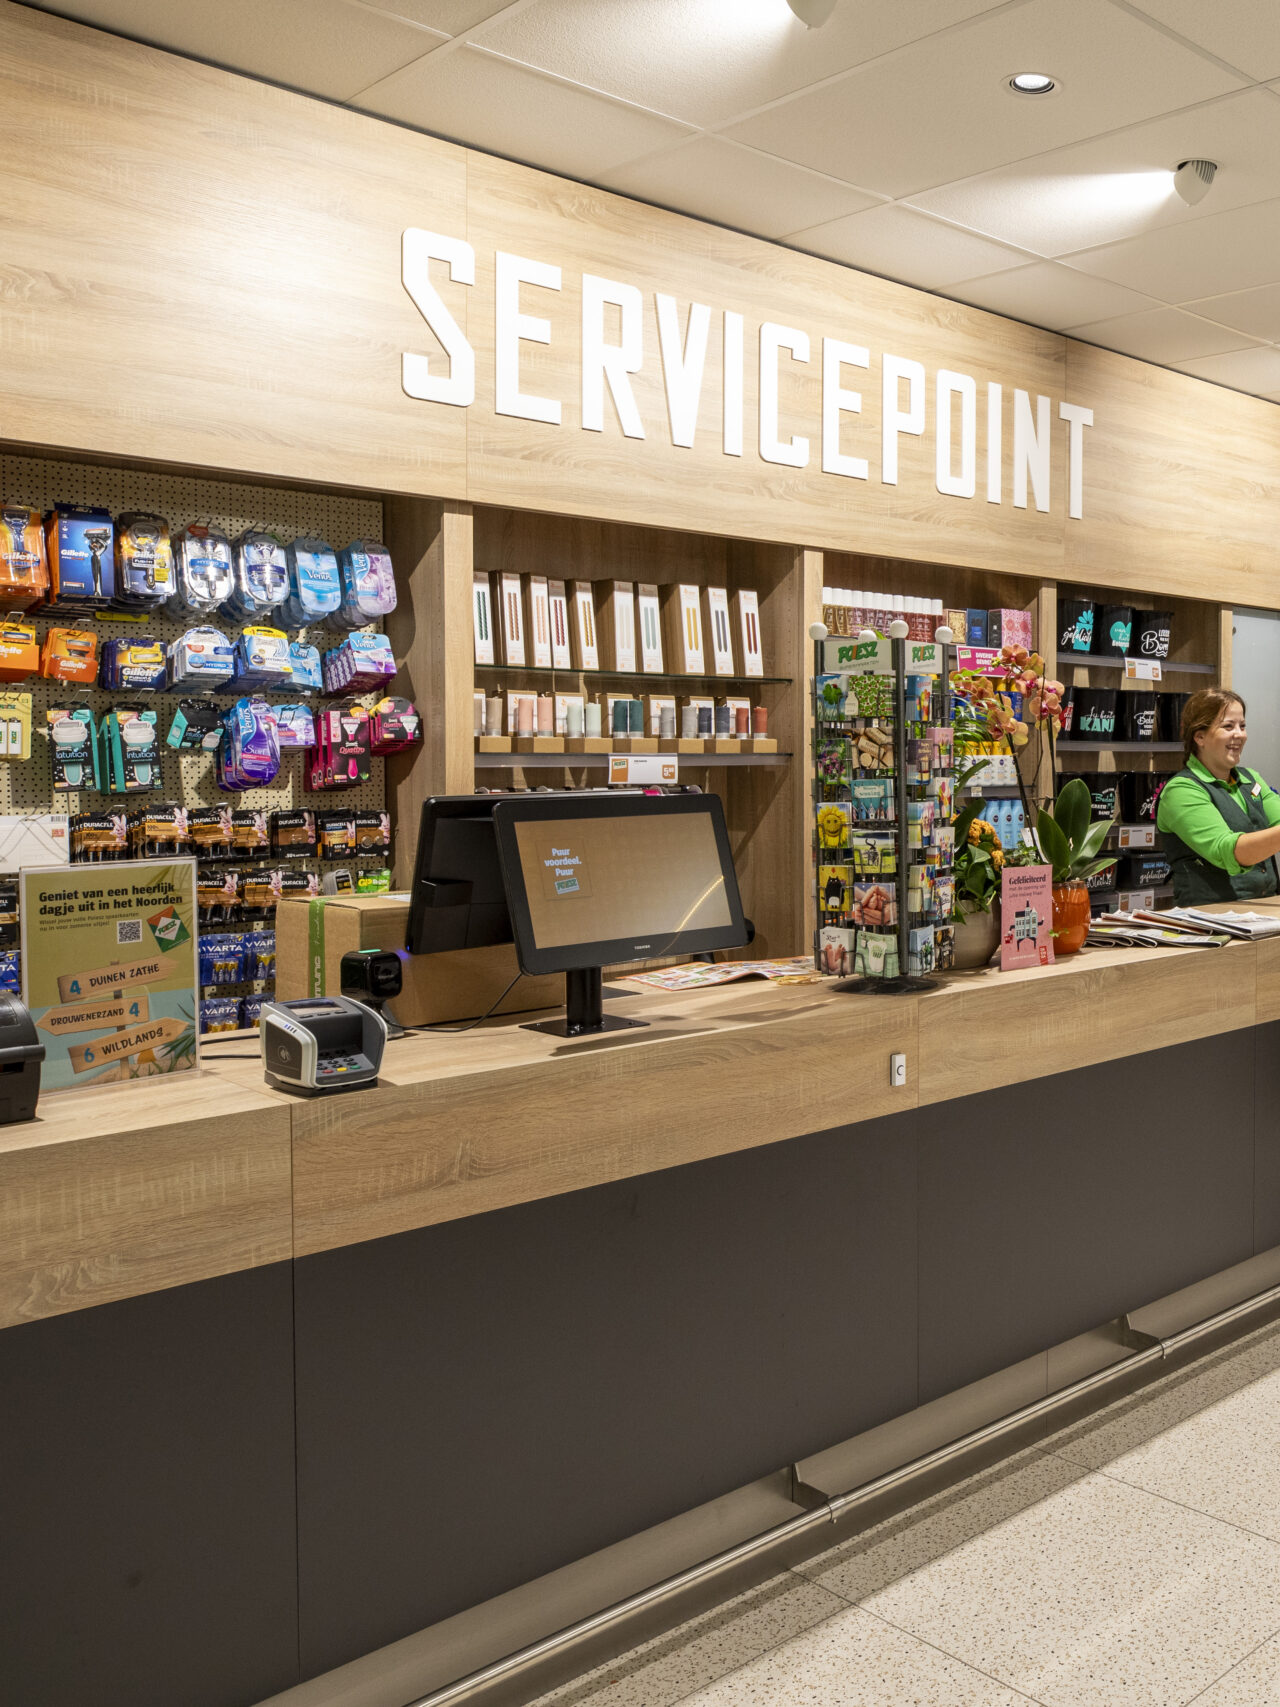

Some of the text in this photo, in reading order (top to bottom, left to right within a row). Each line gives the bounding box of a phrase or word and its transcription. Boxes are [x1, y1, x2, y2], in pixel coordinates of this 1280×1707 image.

[402, 227, 1094, 520] SERVICEPOINT
[60, 549, 89, 558] Gillette
[305, 568, 333, 580] Venus
[352, 639, 377, 649] Venus
[838, 641, 878, 664] POIESZ
[912, 645, 936, 663] POIESZ
[60, 660, 87, 669] Gillette
[122, 667, 159, 678] Gillette
[242, 707, 253, 736] Venus
[56, 750, 88, 759] Intuition
[127, 750, 157, 759] Intuition
[339, 745, 366, 755] Quattro
[552, 848, 570, 856] Puur
[544, 855, 582, 867] voordeel.
[555, 868, 574, 877] Puur
[358, 878, 372, 887] GP
[1009, 874, 1046, 885] Gefeliciteerd
[39, 882, 175, 902] Geniet van een heerlijk
[39, 894, 183, 916] dagje uit in het Noorden
[207, 944, 243, 952] VARTA
[69, 963, 160, 995] 4 DUINEN ZATHE
[50, 1002, 140, 1026] DROUWENERZAND 4
[205, 1007, 237, 1015] VARTA
[84, 1027, 164, 1063] 6 WILDLANDS
